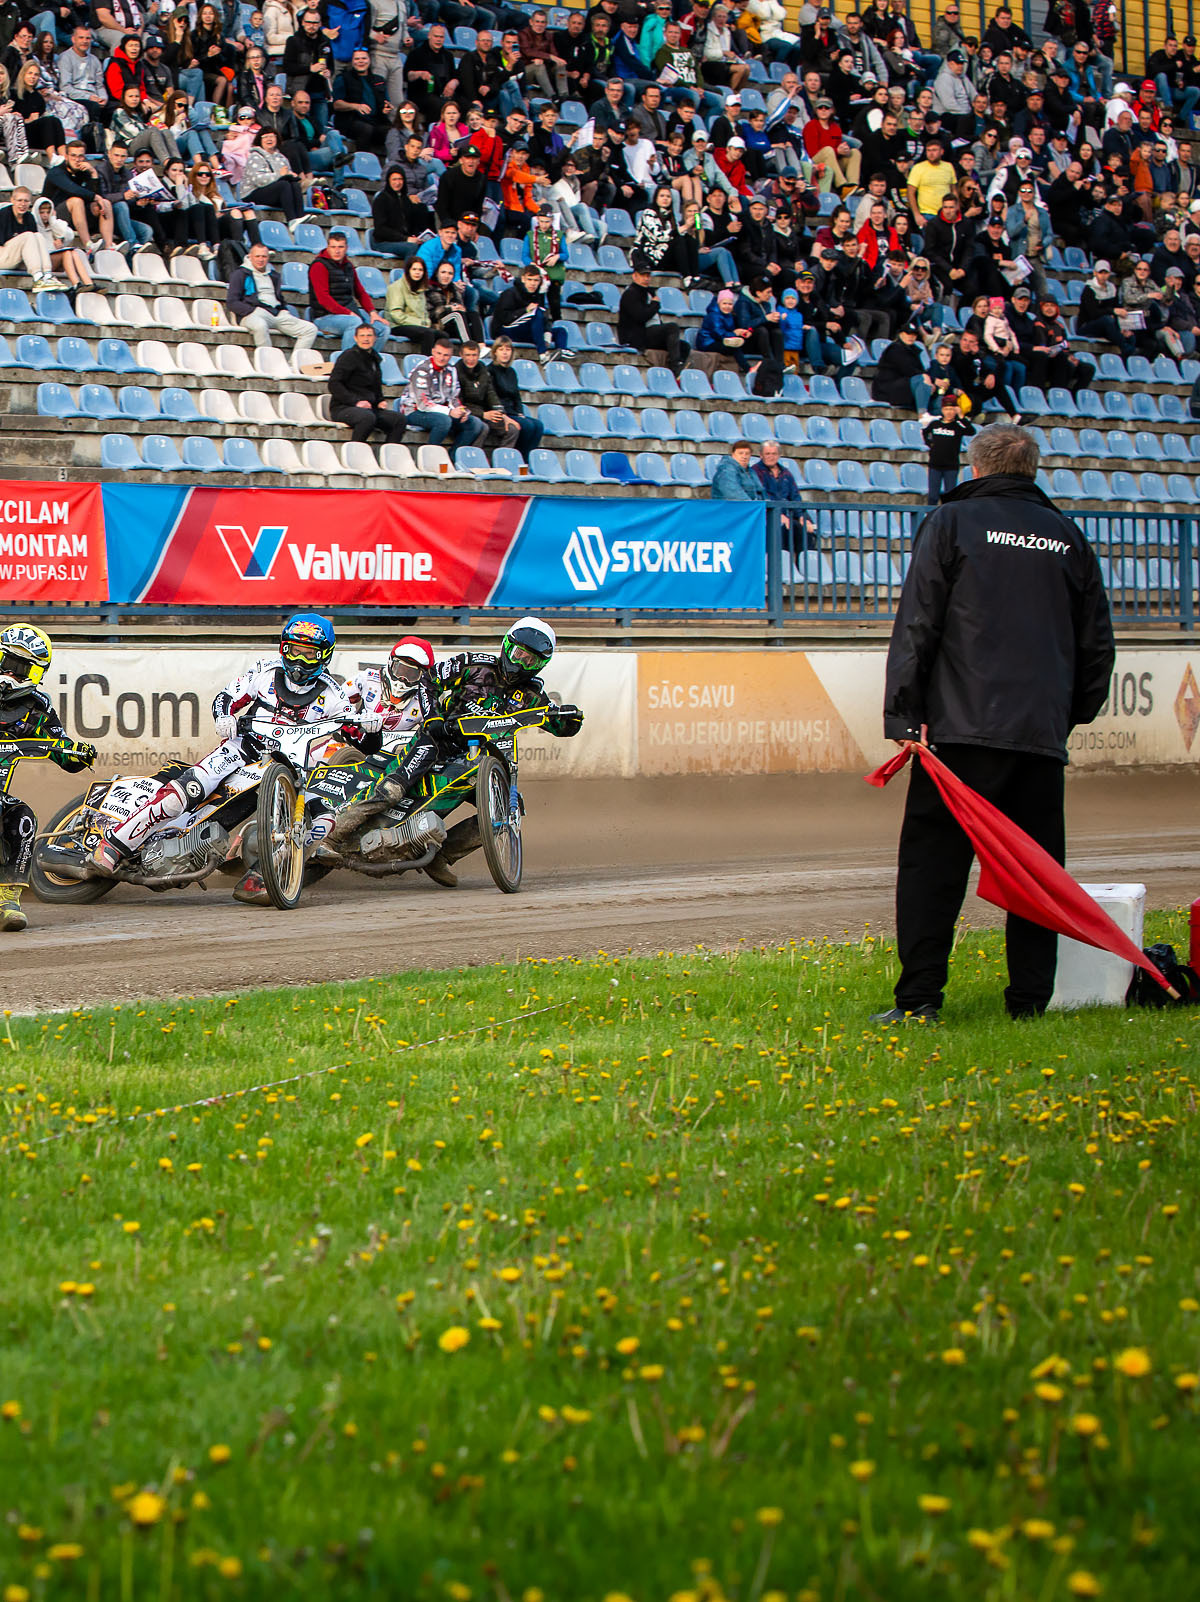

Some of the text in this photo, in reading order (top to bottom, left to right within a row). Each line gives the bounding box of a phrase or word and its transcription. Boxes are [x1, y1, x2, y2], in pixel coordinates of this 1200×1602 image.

[986, 530, 1071, 555] WIRAŻOWY
[288, 543, 433, 581] Valvoline
[611, 540, 732, 573] STOKKER
[648, 680, 735, 708] SĀC SAVU
[286, 727, 321, 735] OPTIBET
[650, 719, 831, 744] KARJERU PIE MUMS!
